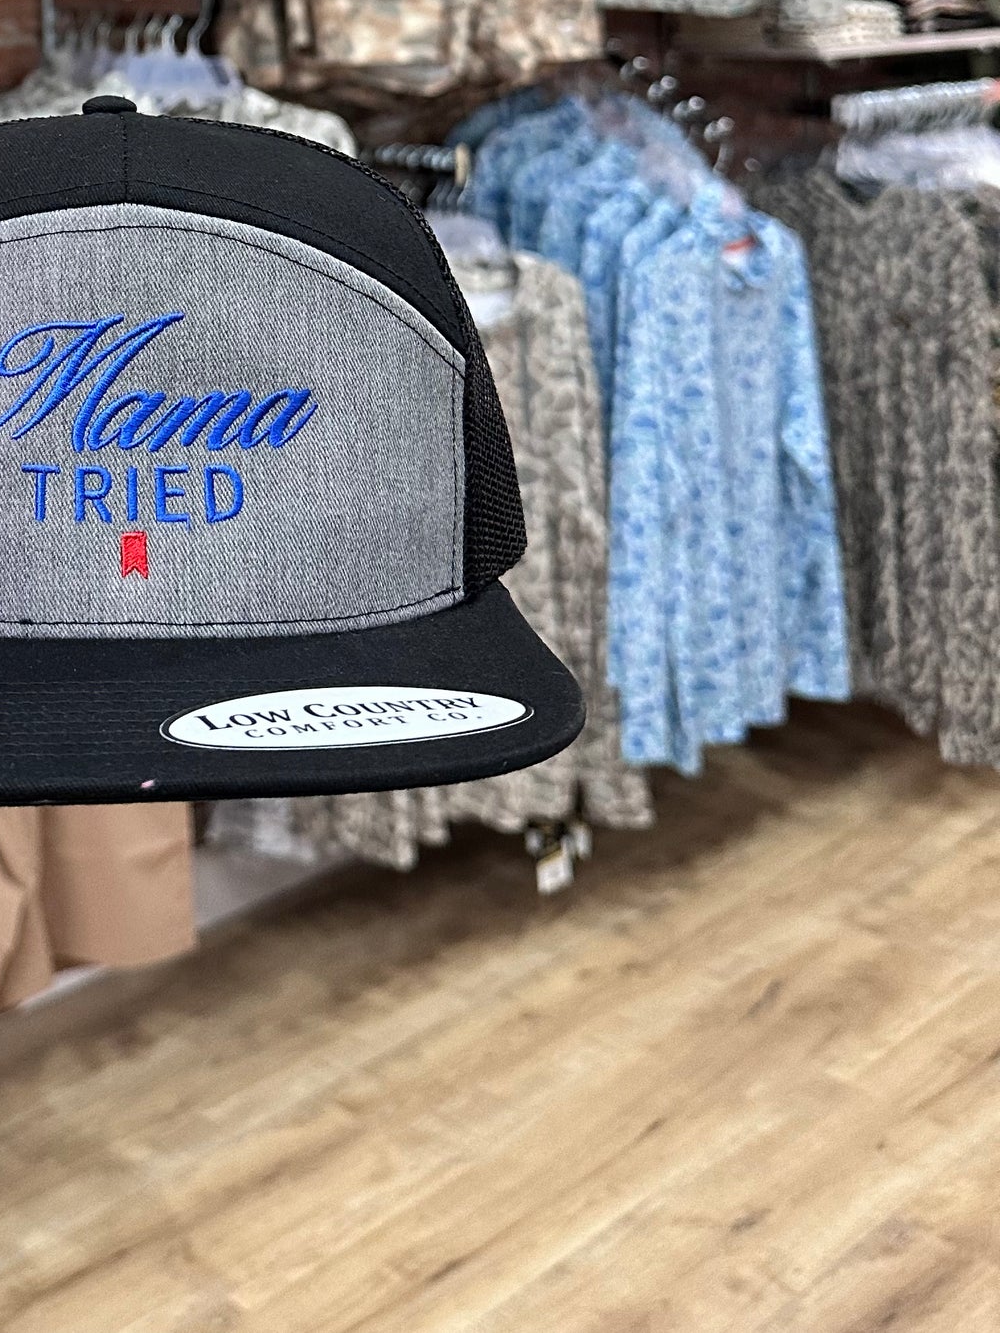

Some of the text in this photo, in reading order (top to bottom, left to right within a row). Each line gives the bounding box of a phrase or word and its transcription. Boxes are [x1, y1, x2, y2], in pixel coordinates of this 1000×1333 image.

[22, 463, 245, 525] TRIED
[197, 697, 482, 731] LOW COUNTRY
[246, 711, 482, 739] COMFORT CO.
